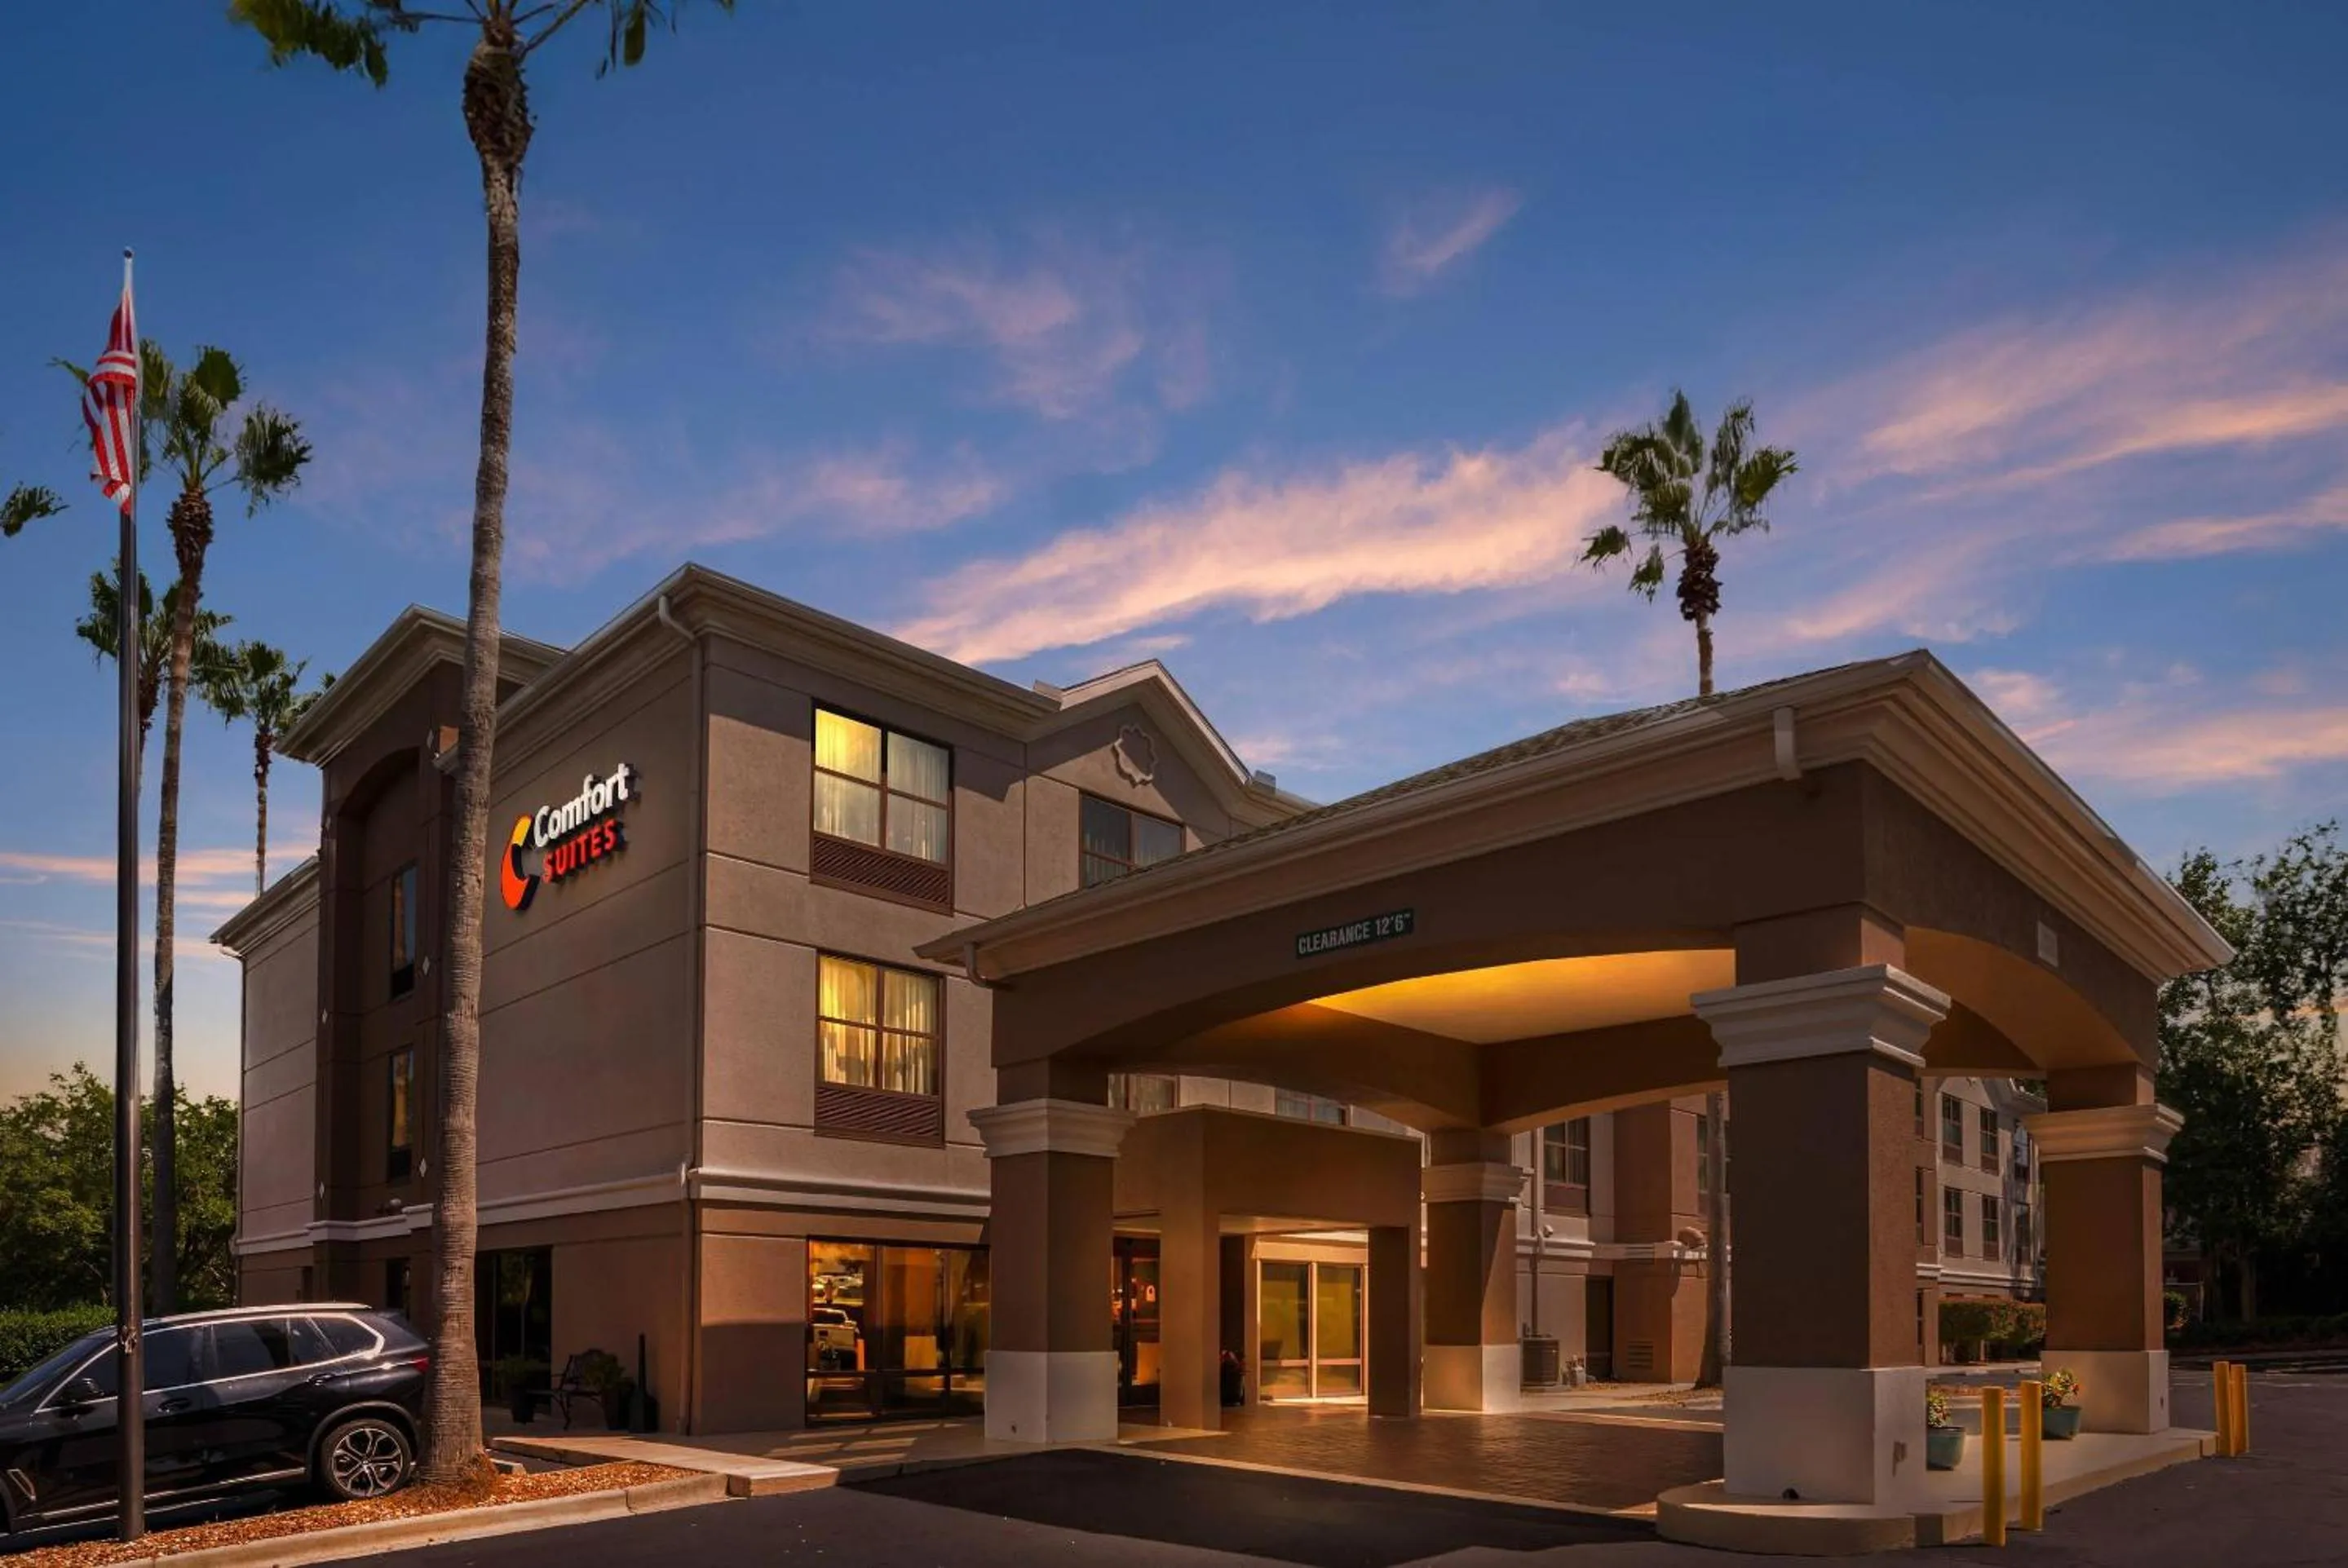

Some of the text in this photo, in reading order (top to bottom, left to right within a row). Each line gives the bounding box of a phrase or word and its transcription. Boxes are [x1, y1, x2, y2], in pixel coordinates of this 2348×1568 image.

[533, 762, 630, 847] Comfort
[542, 819, 617, 884] SUITES
[1298, 921, 1371, 955] CLEARANCE
